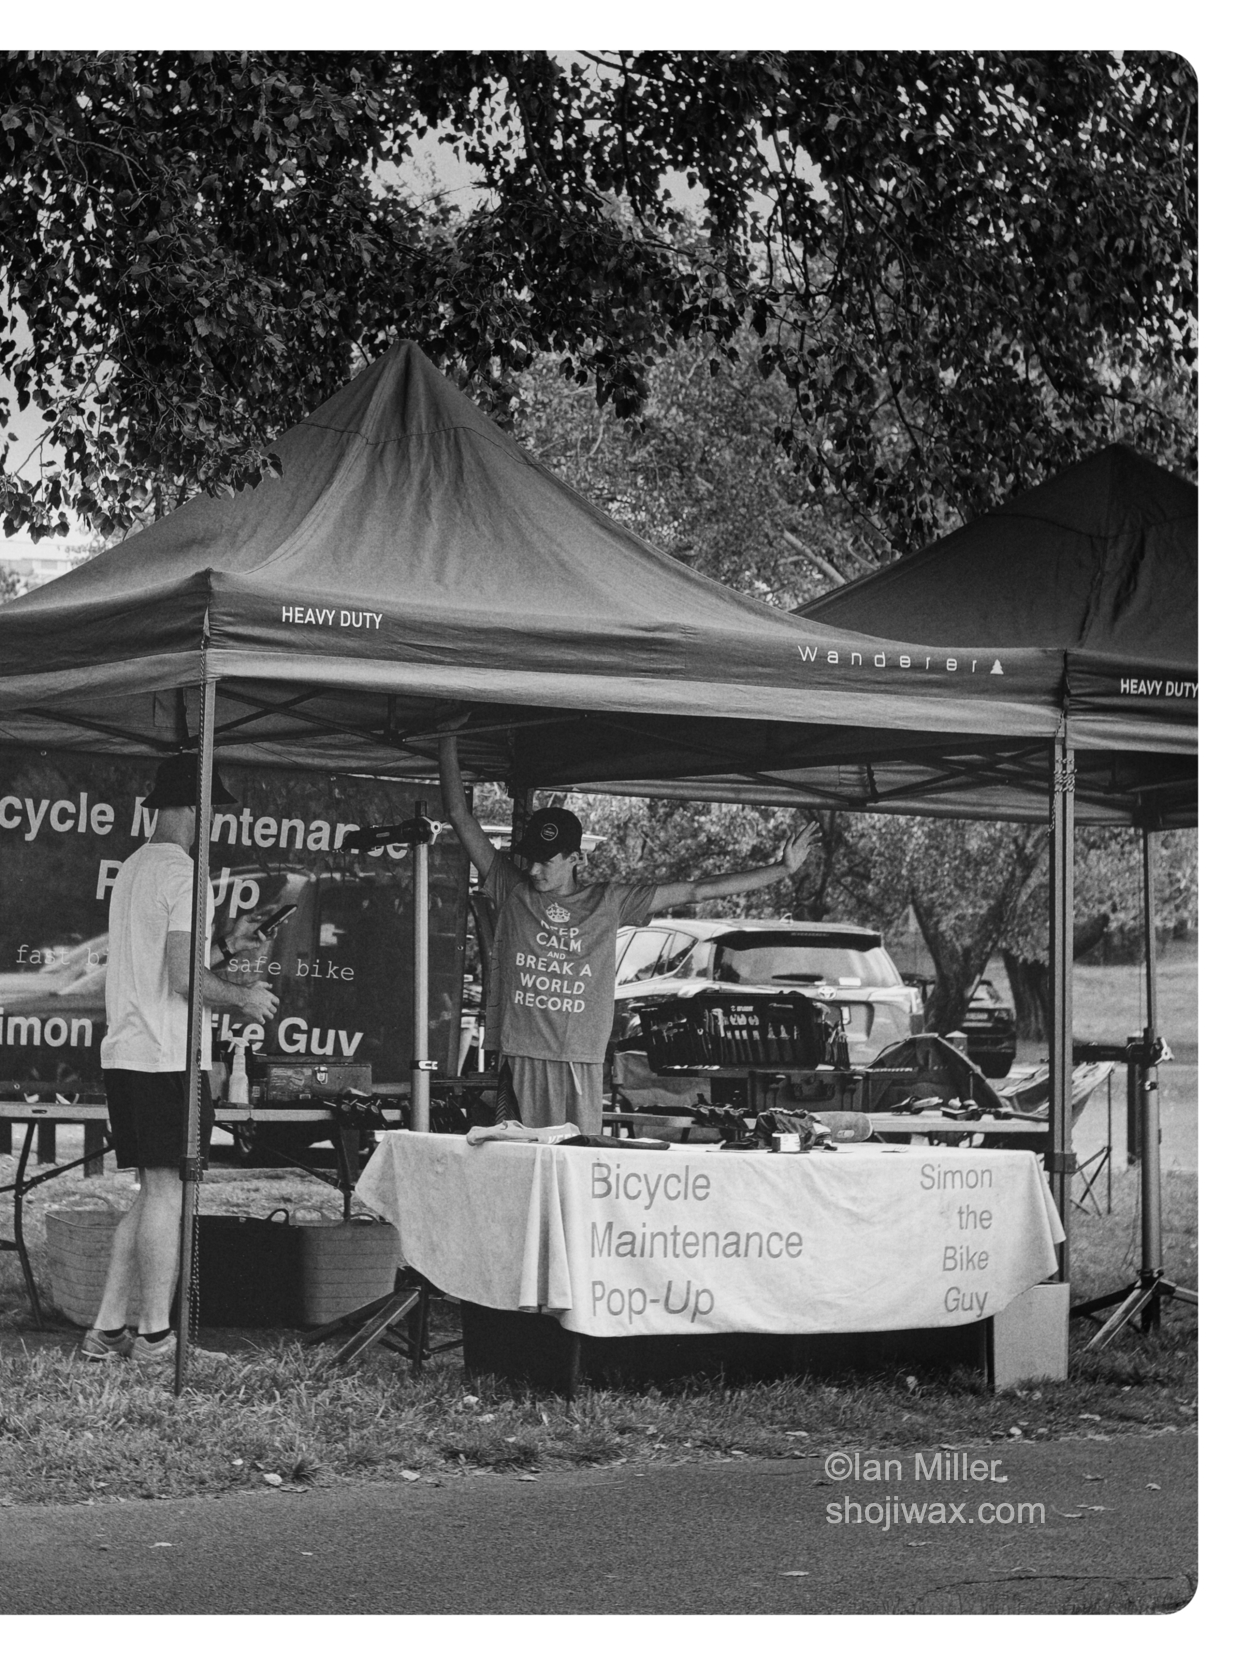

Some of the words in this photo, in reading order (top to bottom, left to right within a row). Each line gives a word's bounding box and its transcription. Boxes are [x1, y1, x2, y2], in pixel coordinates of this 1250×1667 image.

[282, 606, 336, 625] HEAVY
[340, 610, 383, 629] DUTY
[797, 645, 977, 673] Wanderer
[1120, 678, 1163, 696] HEAVY
[1165, 681, 1198, 698] DUTY
[536, 932, 582, 953] CALM
[547, 951, 566, 960] AND
[16, 944, 71, 965] fast
[227, 956, 282, 976] safe
[295, 958, 355, 981] bike
[516, 952, 575, 976] BREAK
[579, 963, 592, 977] A
[520, 972, 585, 995] WORLD
[514, 990, 585, 1013] RECORD
[591, 1161, 711, 1211] Bicycle
[920, 1163, 993, 1190] Simon
[957, 1204, 993, 1230] the
[591, 1221, 803, 1259] Maintenance
[942, 1245, 989, 1271] Bike
[591, 1279, 715, 1325] Pop-Up
[944, 1286, 989, 1318] Guy
